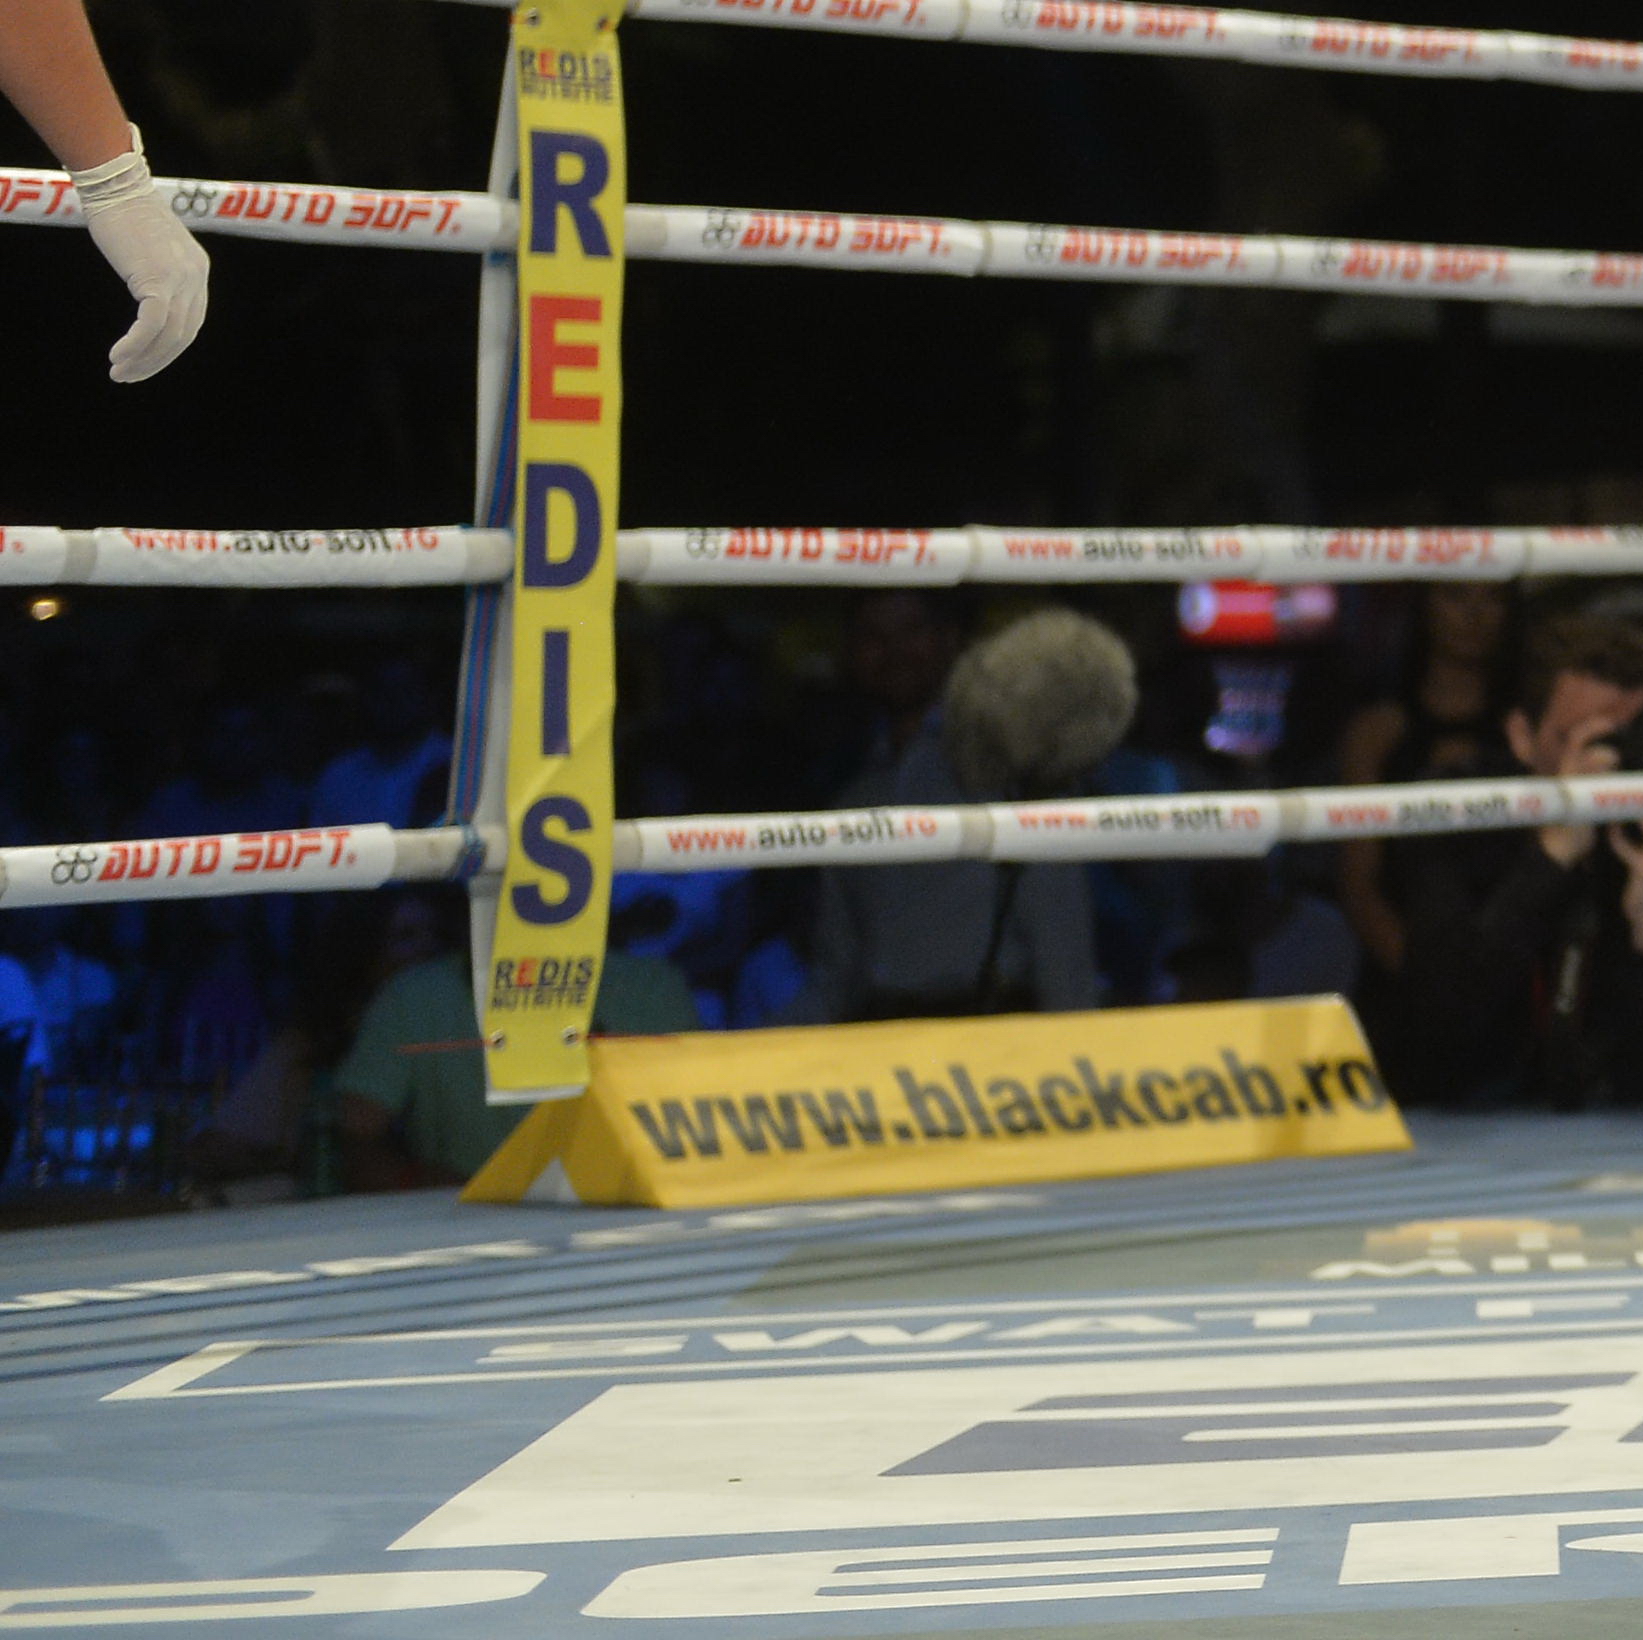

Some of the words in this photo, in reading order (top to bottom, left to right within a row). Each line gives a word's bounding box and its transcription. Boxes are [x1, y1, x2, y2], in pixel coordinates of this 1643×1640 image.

[216, 184, 337, 225] AUTO
[740, 213, 843, 250] AUTO
[1059, 227, 1150, 267] AUTO
[511, 130, 613, 927] REDIS
[724, 527, 825, 561] AUTO
[99, 836, 223, 881] AUTO
[494, 957, 595, 989] REDIS
[629, 1049, 1387, 1160] www.blackcab.ro
[476, 1301, 1377, 1364] SWAT
